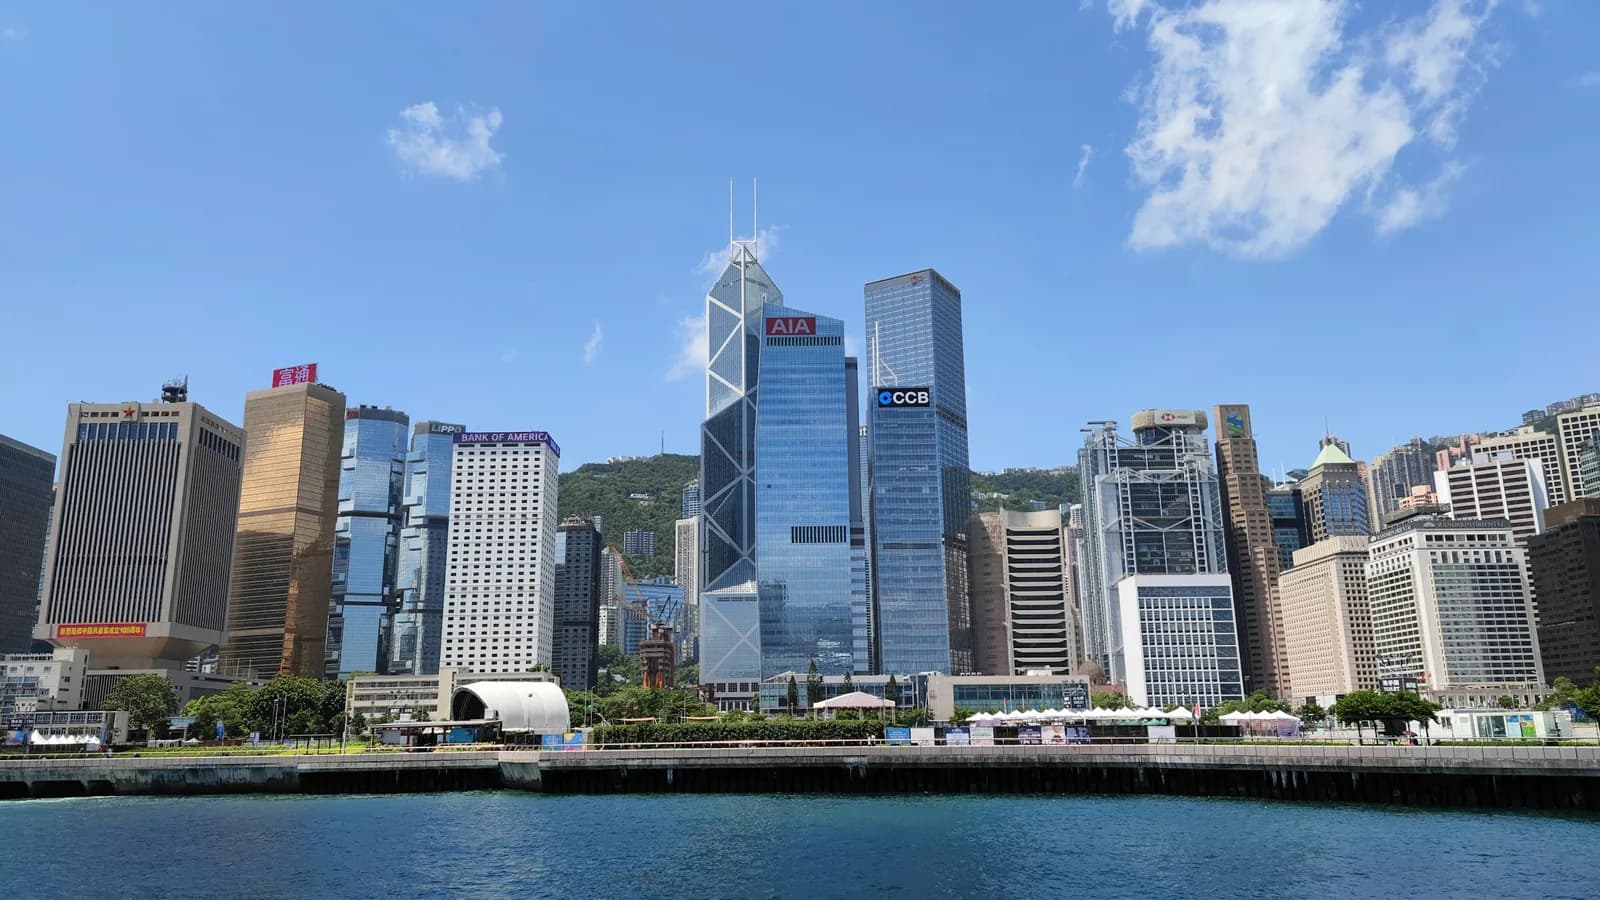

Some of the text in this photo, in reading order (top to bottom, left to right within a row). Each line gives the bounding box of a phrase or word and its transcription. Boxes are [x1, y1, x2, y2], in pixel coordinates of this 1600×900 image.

[771, 318, 810, 334] AIA
[892, 391, 929, 404] CCB
[431, 424, 462, 433] LIPPO
[461, 433, 489, 442] BANK
[491, 433, 505, 441] OF
